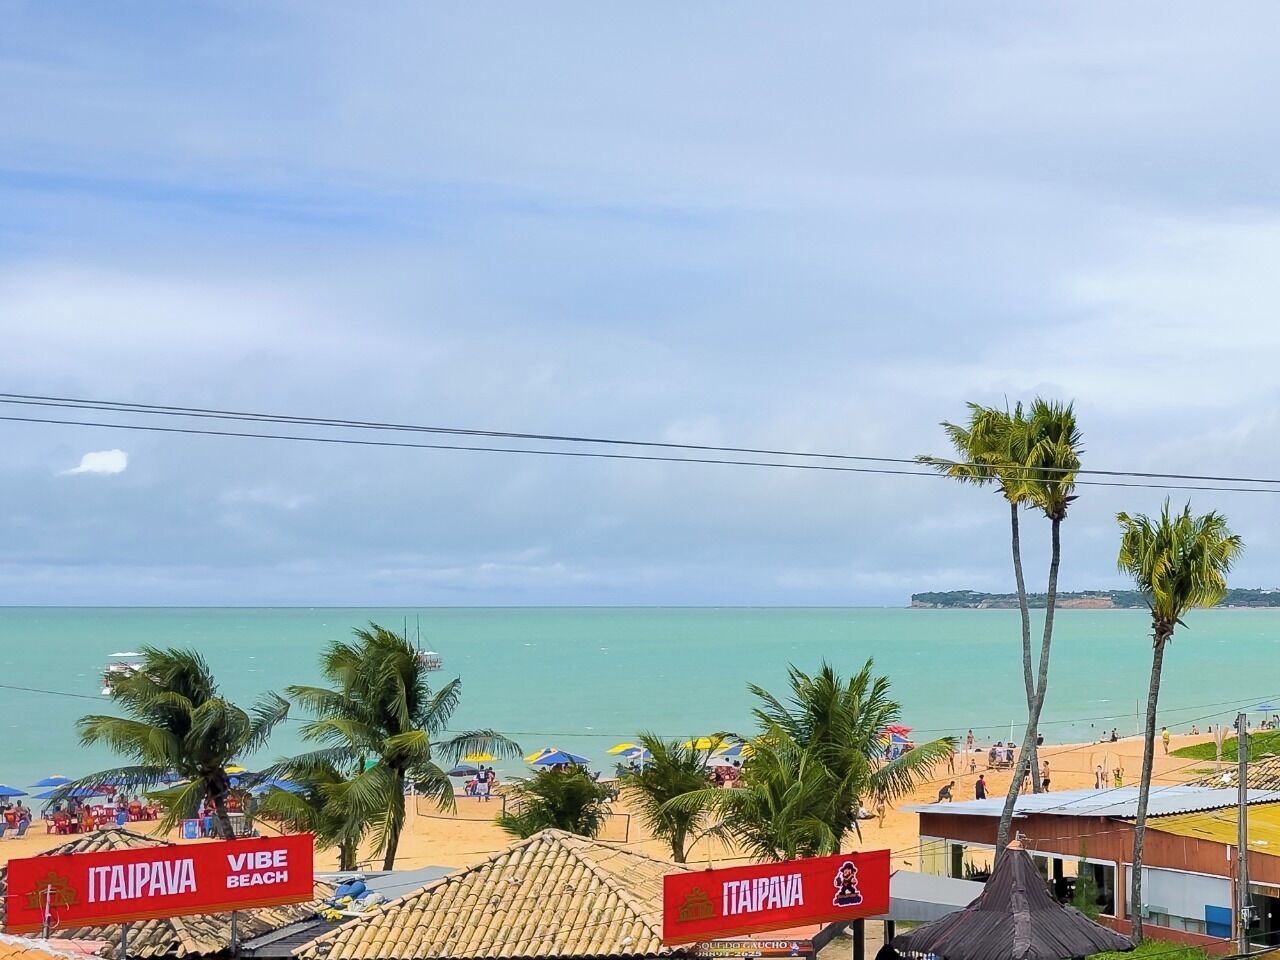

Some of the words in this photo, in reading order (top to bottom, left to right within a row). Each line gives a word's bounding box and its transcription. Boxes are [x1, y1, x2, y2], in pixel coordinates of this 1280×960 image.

[227, 849, 288, 871] VIBE
[88, 858, 197, 902] ITAIPAVA
[226, 870, 288, 888] BEACH
[722, 873, 804, 916] ITAIPAVA
